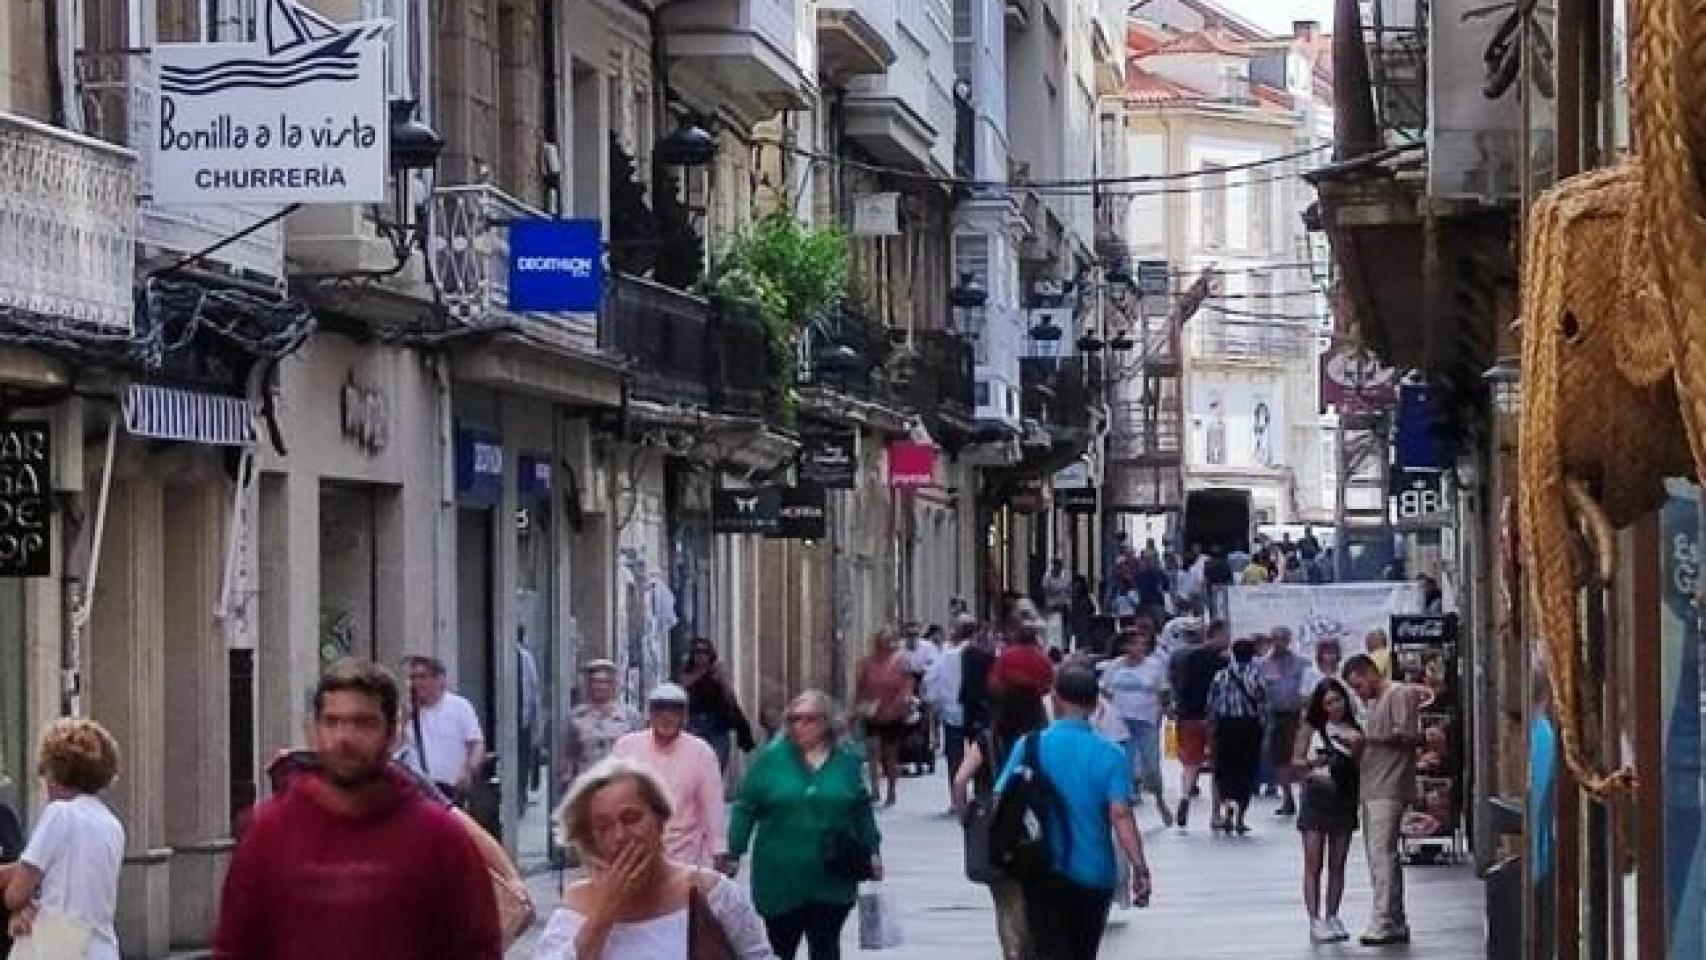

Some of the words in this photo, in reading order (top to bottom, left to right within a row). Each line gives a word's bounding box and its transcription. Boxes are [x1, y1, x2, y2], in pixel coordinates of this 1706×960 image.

[160, 95, 249, 150] Bonilla
[255, 123, 271, 149] a
[280, 112, 302, 149] la
[309, 112, 377, 149] vista
[195, 161, 347, 188] CHURRERÍA
[517, 256, 592, 271] DECATHLON
